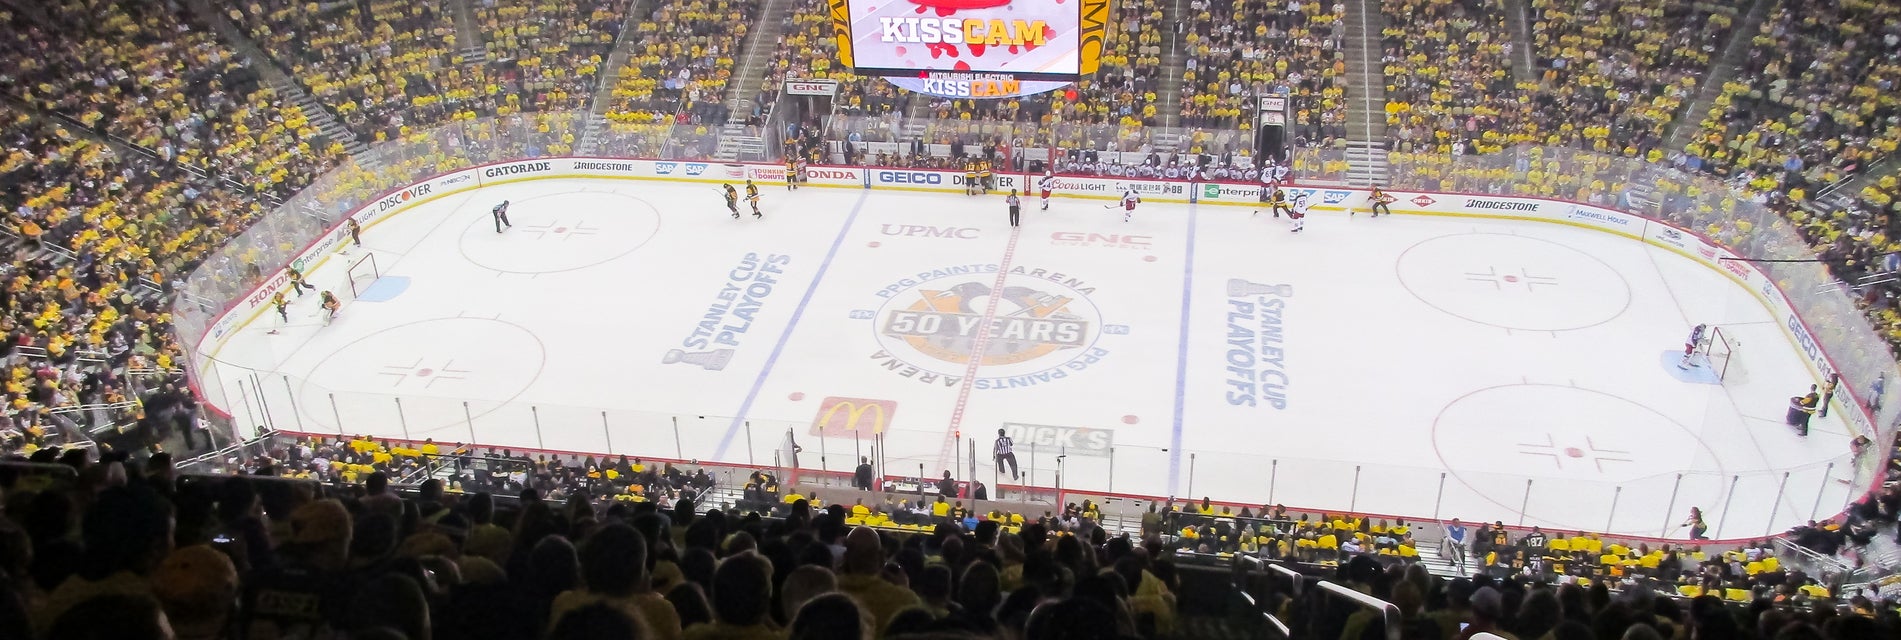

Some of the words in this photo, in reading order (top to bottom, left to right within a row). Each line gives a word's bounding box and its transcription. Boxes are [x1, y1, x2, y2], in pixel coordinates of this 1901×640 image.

[928, 72, 974, 81] MITSUBISHI
[486, 162, 551, 178] GATORADE
[573, 161, 633, 171] BRIDGESTONE
[656, 164, 675, 174] SAP
[686, 165, 704, 175] SAP
[806, 170, 857, 180] ONDA
[879, 171, 942, 184] GEICO
[1051, 178, 1080, 190] Coors
[1080, 183, 1106, 192] LIGHT
[1207, 187, 1260, 198] enterpri
[379, 183, 431, 212] DISCOVER
[1324, 192, 1346, 203] SAP
[1465, 199, 1540, 212] BRIDGESTONE
[359, 209, 376, 225] LIGHT
[880, 223, 981, 239] UPMC
[1051, 231, 1153, 245] GNC
[876, 278, 918, 299] PPG
[917, 264, 1000, 281] PAINTS
[1010, 265, 1096, 295] ARENA
[683, 282, 742, 350] STANLEY
[730, 252, 760, 282] CUP
[714, 254, 791, 347] PLAYOFFS
[891, 311, 942, 335] 50
[958, 315, 1081, 343] YEARS
[1258, 296, 1285, 369] STANLEY
[1788, 314, 1817, 361] GEICO
[1064, 346, 1110, 372] PPG
[1226, 299, 1257, 408] PLAYOFFS
[870, 350, 962, 389] ARENA
[974, 367, 1070, 390] PAINTS
[1260, 369, 1289, 410] CUP
